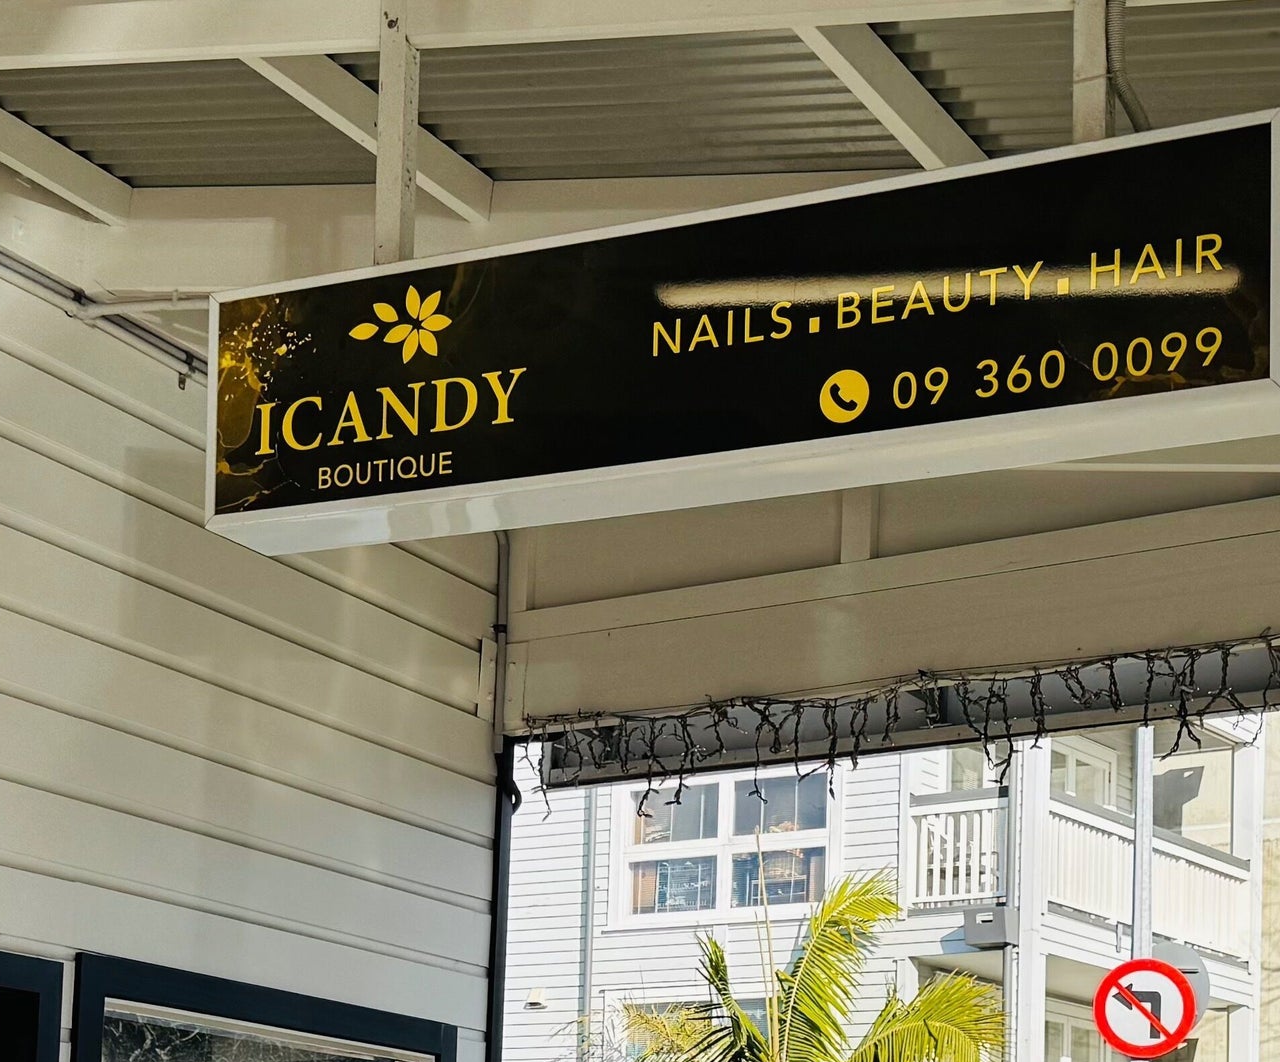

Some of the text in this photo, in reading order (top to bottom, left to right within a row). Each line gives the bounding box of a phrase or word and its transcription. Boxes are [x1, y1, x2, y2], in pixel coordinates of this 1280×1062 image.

[651, 233, 1224, 357] NAILS BEAUTY HAIR
[893, 326, 1222, 409] 09 360 0099
[254, 367, 526, 455] ICANDY
[317, 452, 453, 489] BOUTIQUE
